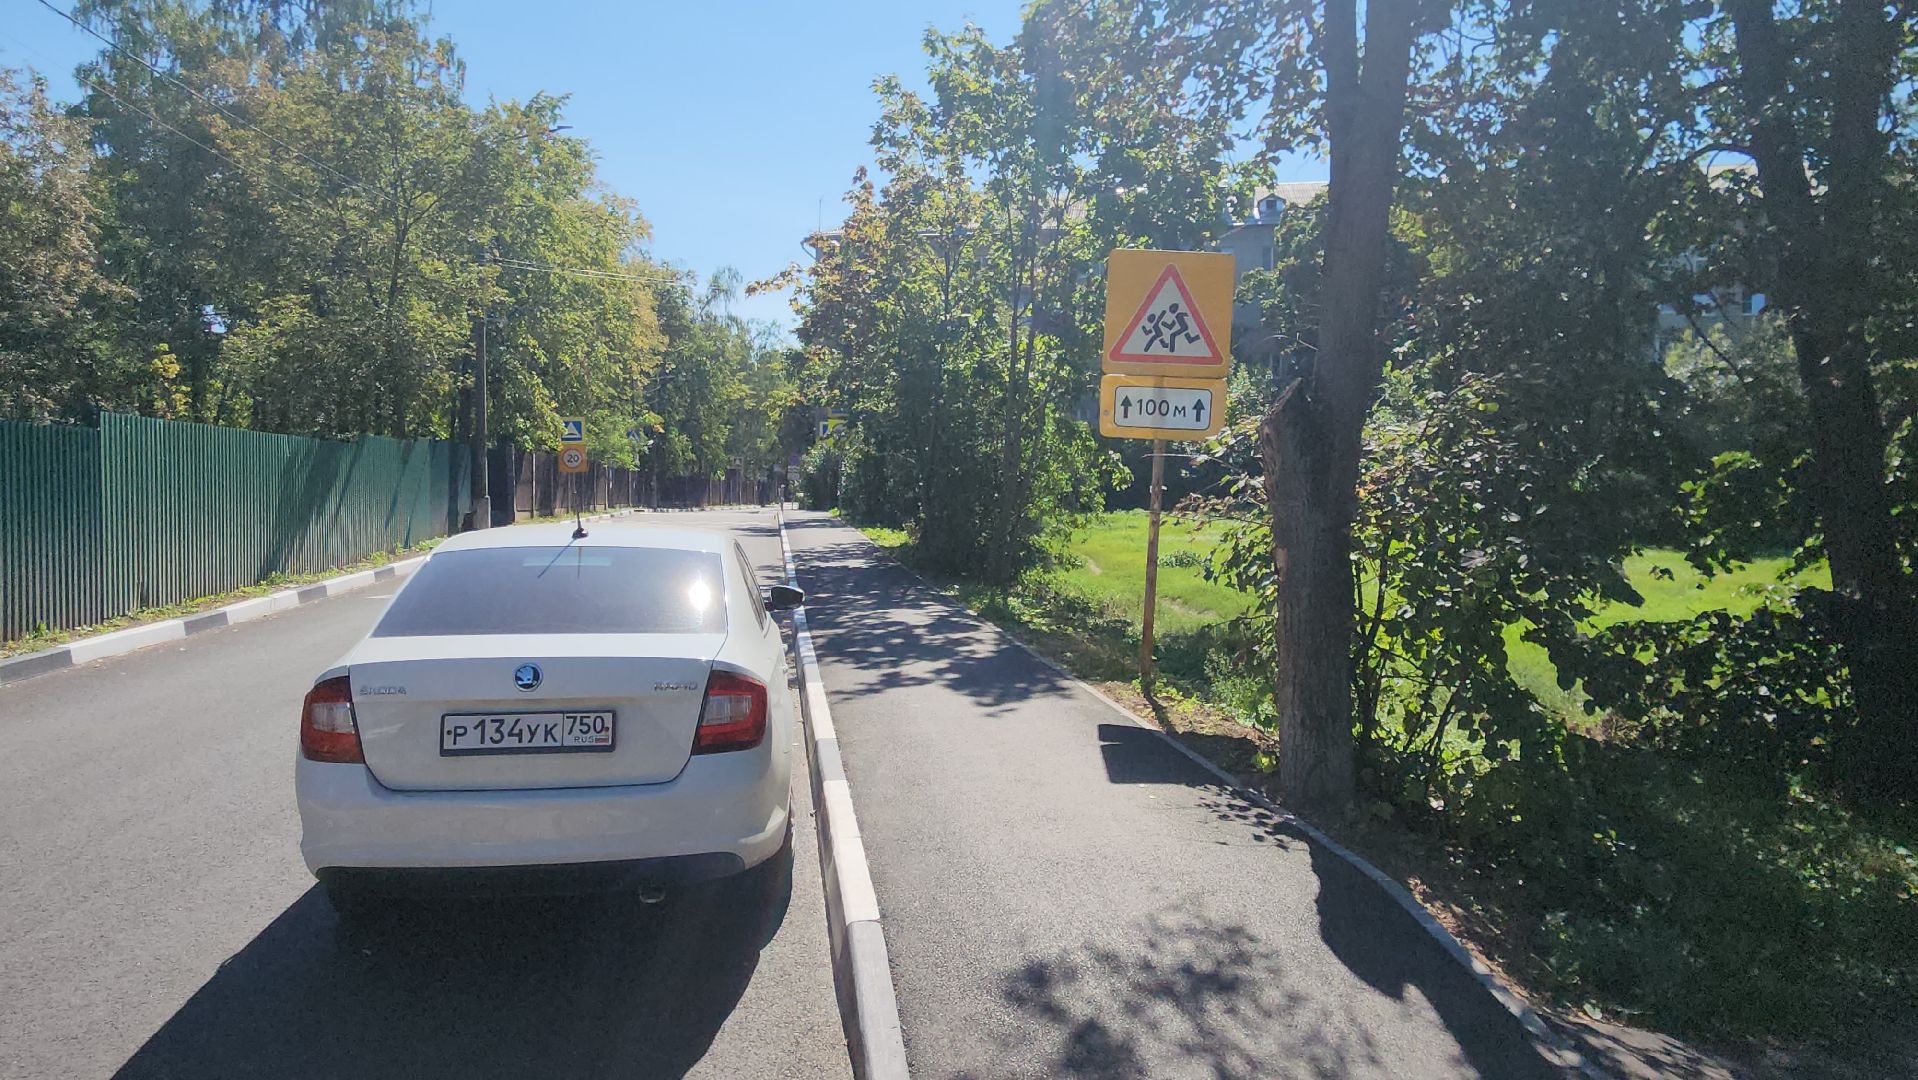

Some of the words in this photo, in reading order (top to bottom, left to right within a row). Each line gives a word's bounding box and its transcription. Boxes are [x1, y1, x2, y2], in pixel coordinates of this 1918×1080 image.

[1136, 398, 1170, 417] 100
[567, 453, 580, 463] 20
[565, 715, 605, 736] 750
[573, 735, 594, 744] RUS
